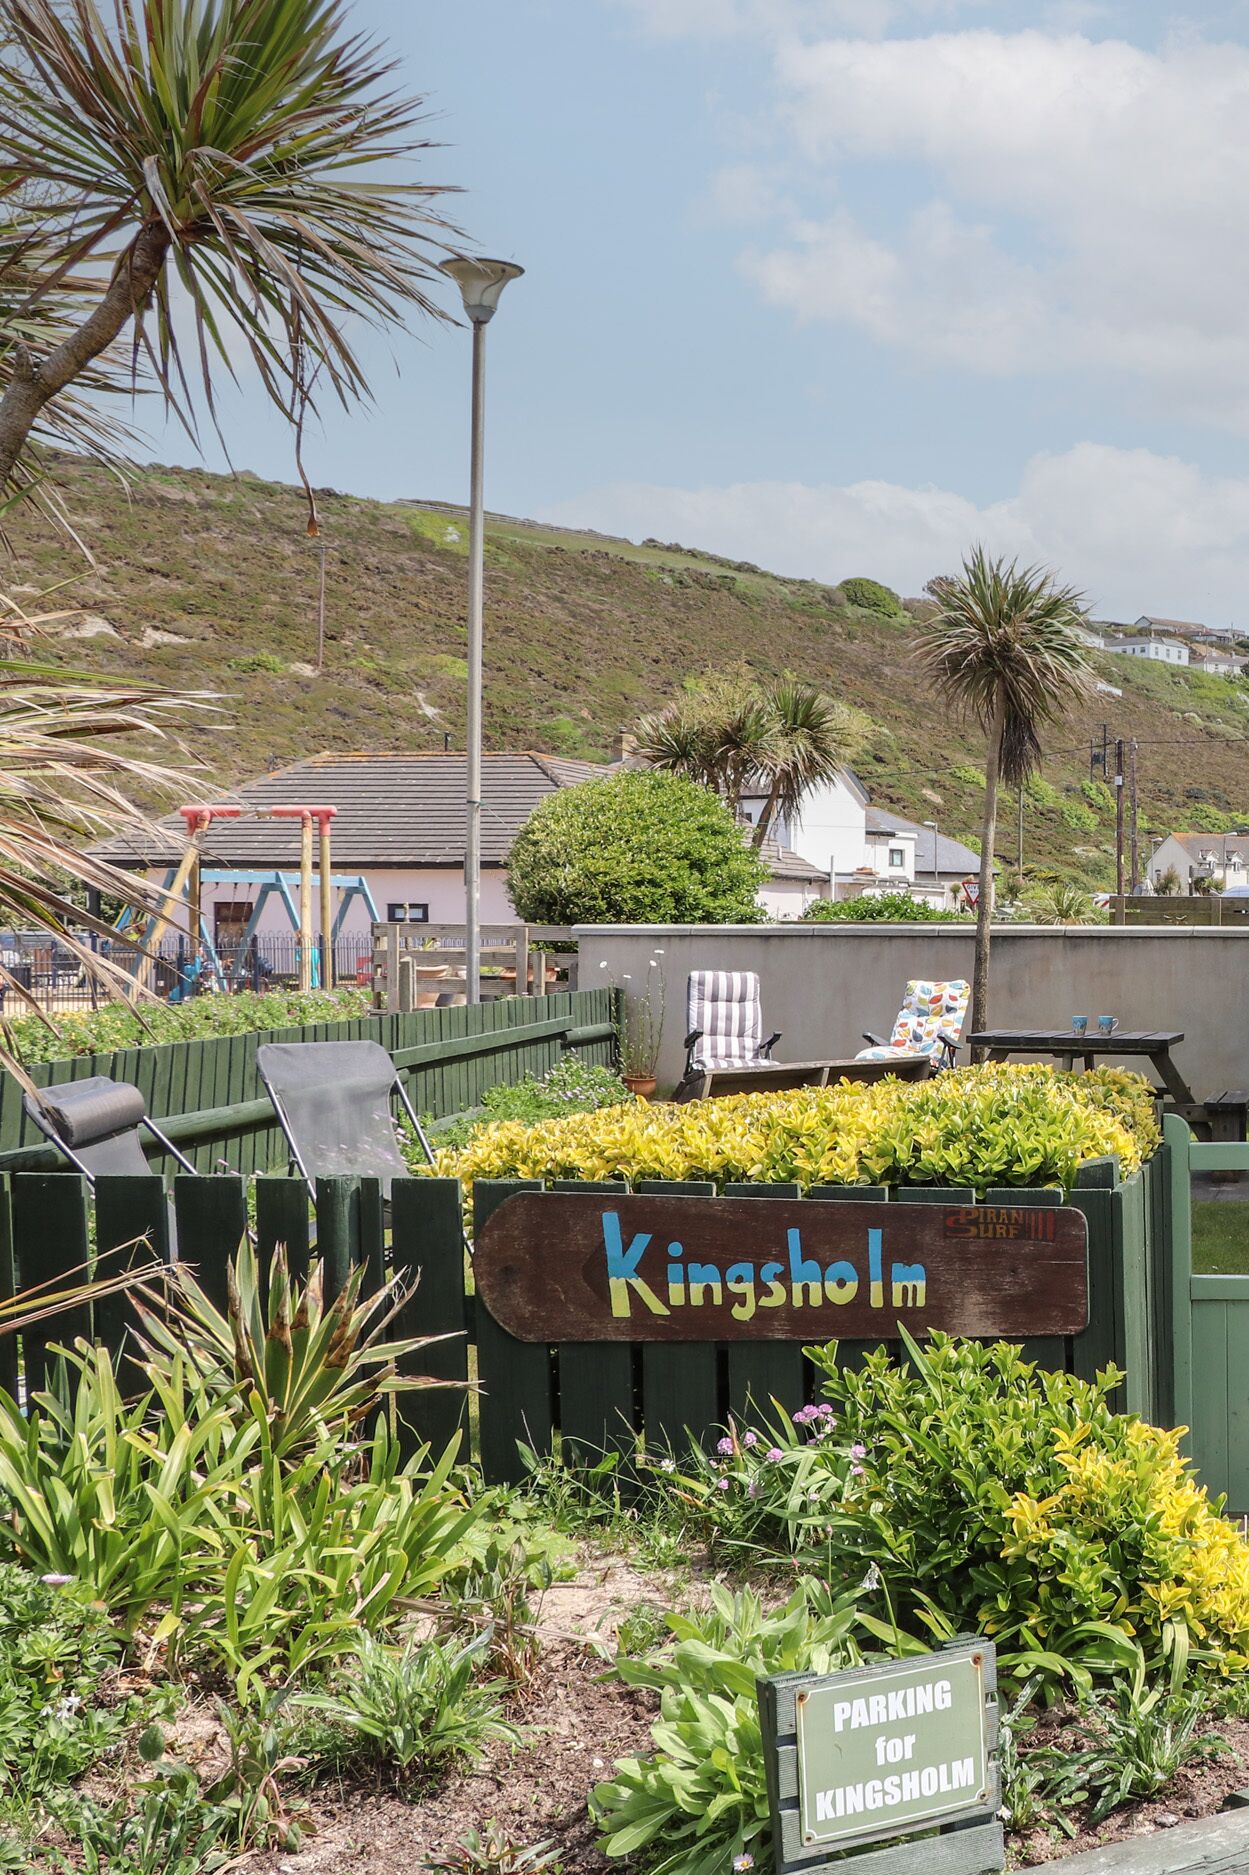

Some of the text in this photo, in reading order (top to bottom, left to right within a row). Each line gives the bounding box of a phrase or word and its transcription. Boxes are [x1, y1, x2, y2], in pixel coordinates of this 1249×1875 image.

[946, 1216, 1021, 1239] SURF
[957, 1206, 1025, 1224] PIRAN
[602, 1211, 926, 1322] Kingsholm
[833, 1680, 952, 1733] PARKING
[875, 1733, 916, 1766] for
[815, 1757, 975, 1822] KINGSHOLM
